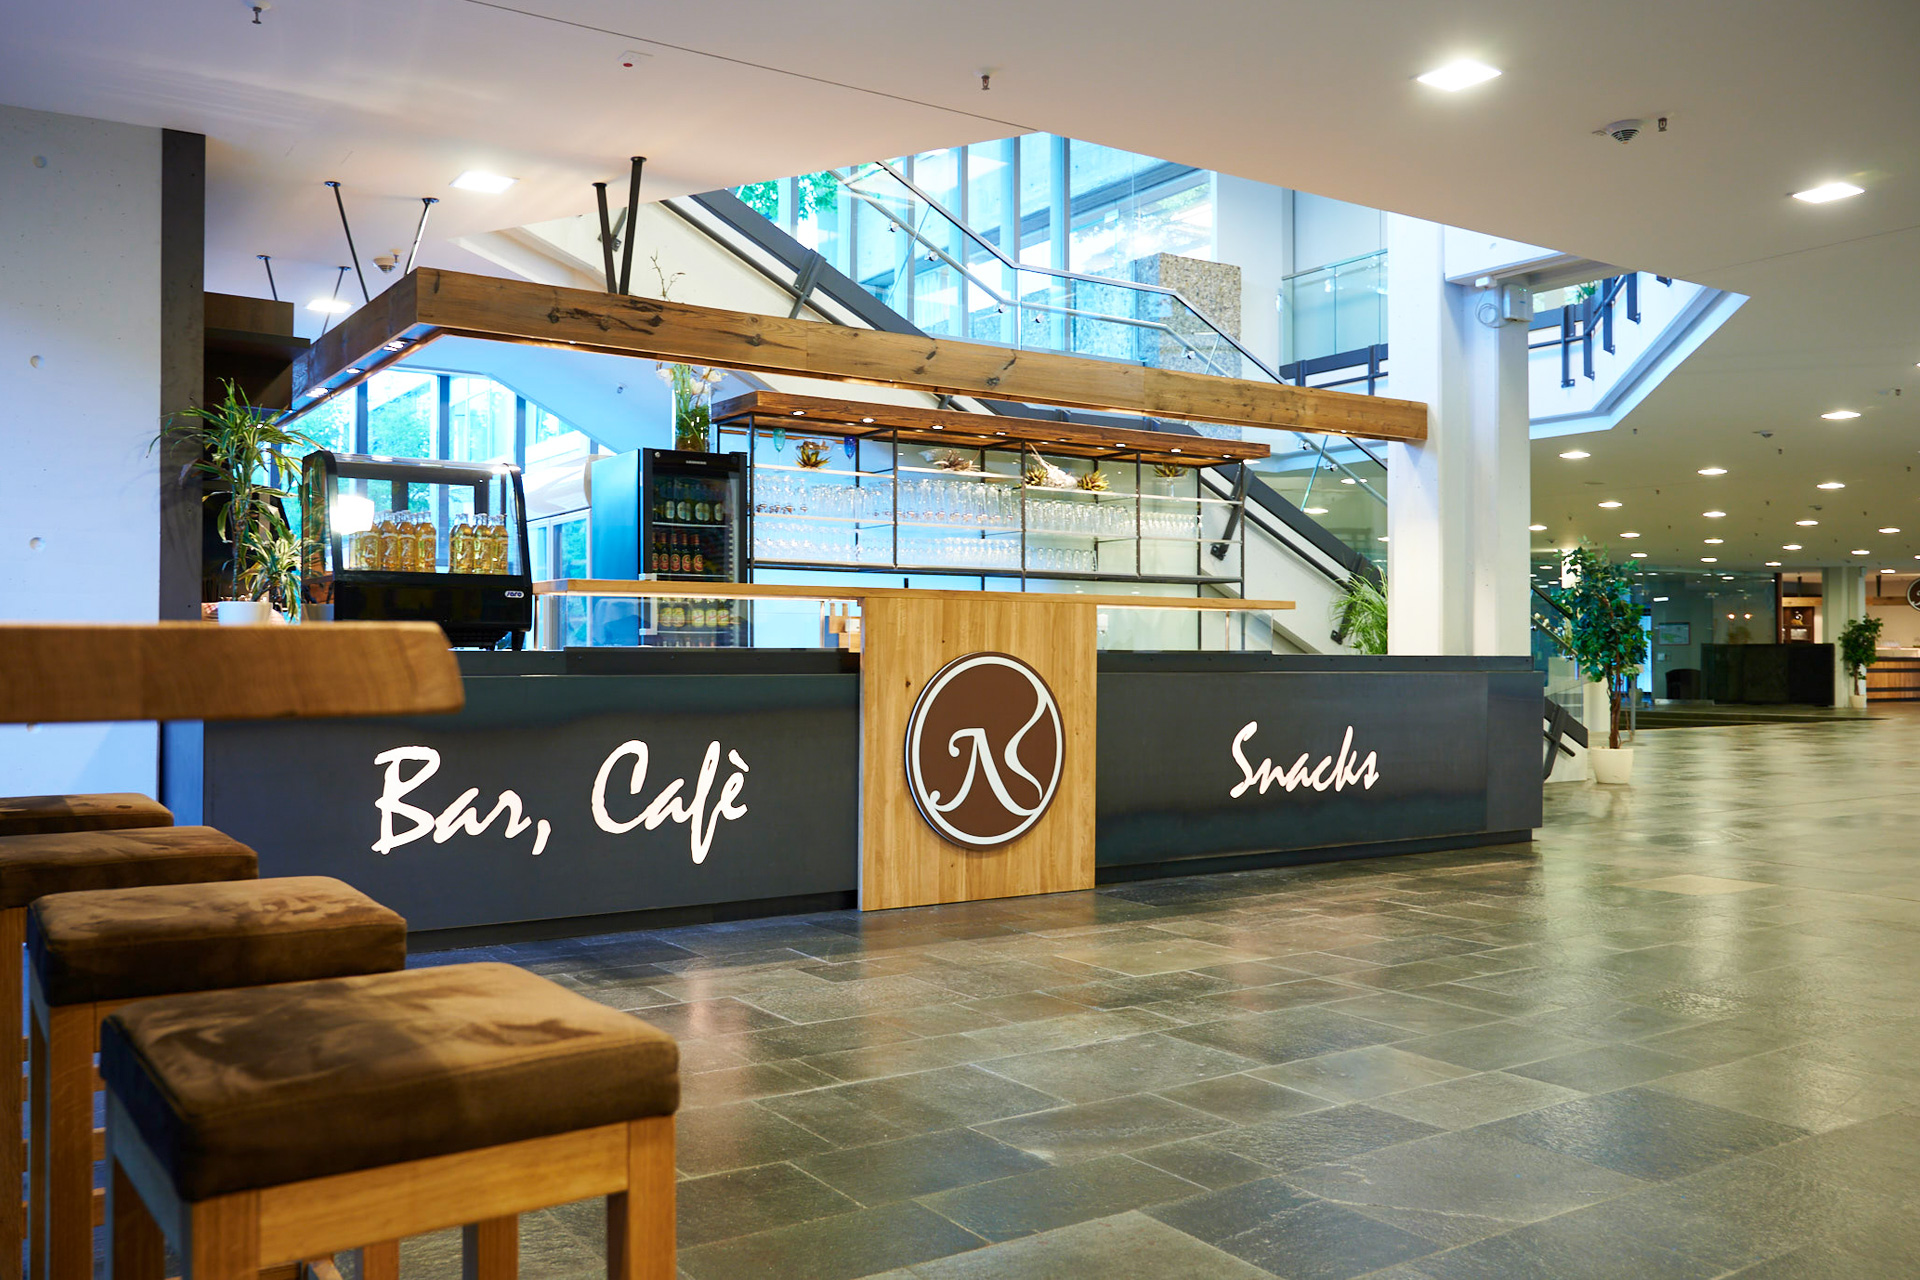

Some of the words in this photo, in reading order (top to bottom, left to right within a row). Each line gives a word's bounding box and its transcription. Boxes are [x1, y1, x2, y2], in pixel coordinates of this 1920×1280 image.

[371, 746, 551, 855] Bar,
[592, 740, 749, 864] Cafè
[1230, 721, 1379, 798] Snacks
